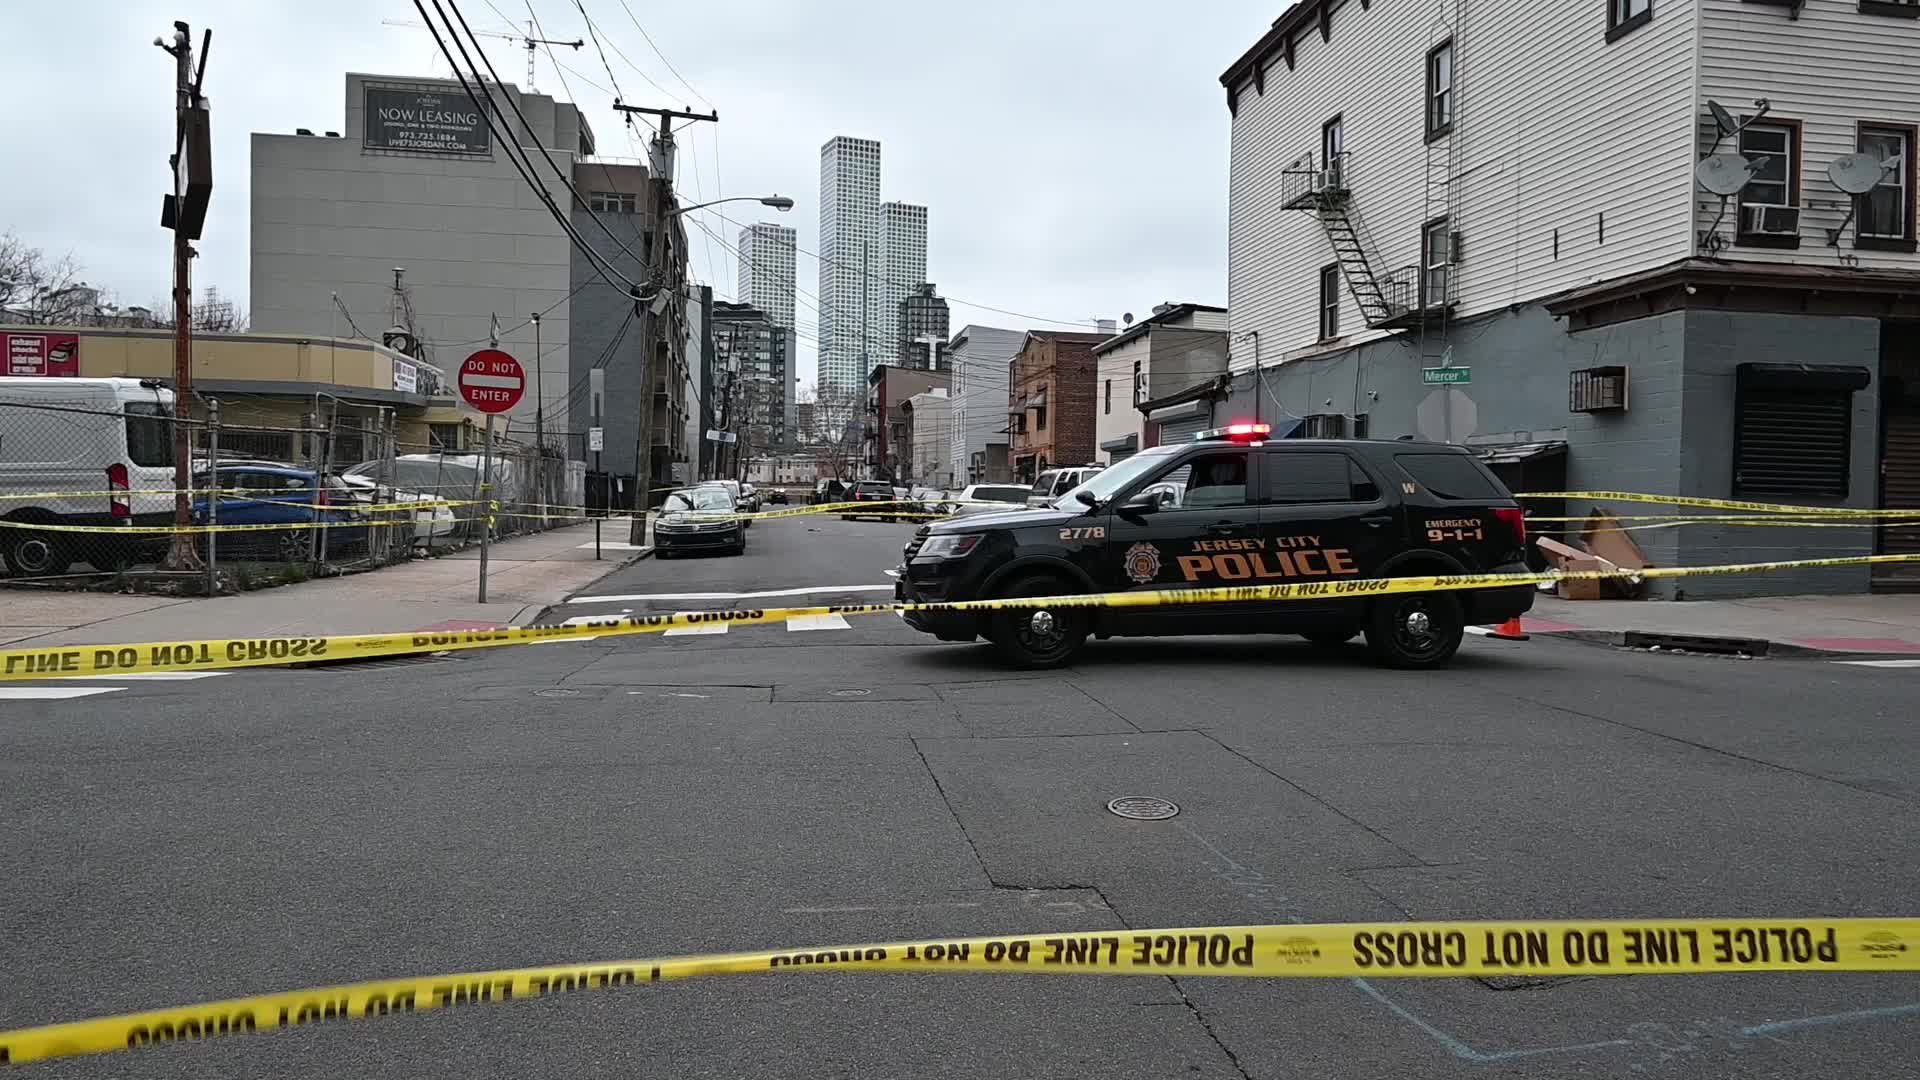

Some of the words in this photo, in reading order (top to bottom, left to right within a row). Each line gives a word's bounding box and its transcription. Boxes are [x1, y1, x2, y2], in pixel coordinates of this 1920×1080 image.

[378, 108, 415, 121] NOW
[419, 110, 478, 125] LEASING
[468, 361, 485, 371] DO
[492, 362, 516, 373] NOT
[1424, 371, 1458, 382] Mercer
[472, 389, 510, 401] ENTER
[1401, 482, 1416, 495] W
[1059, 527, 1105, 539] 2778
[1425, 518, 1482, 529] EMERGENCY
[1191, 538, 1266, 552] JERSEY
[1277, 536, 1321, 548] CITY
[1427, 529, 1483, 542] 9-1-1
[1175, 548, 1360, 581] POLICE
[984, 939, 1030, 964] DO
[1044, 937, 1120, 966] LINE
[1133, 933, 1254, 968] POLICE
[1353, 931, 1466, 967] CROSS
[1481, 931, 1549, 967] NOT
[1563, 929, 1609, 965] DO
[1624, 928, 1700, 964] LINE
[1712, 927, 1839, 963] POLICE
